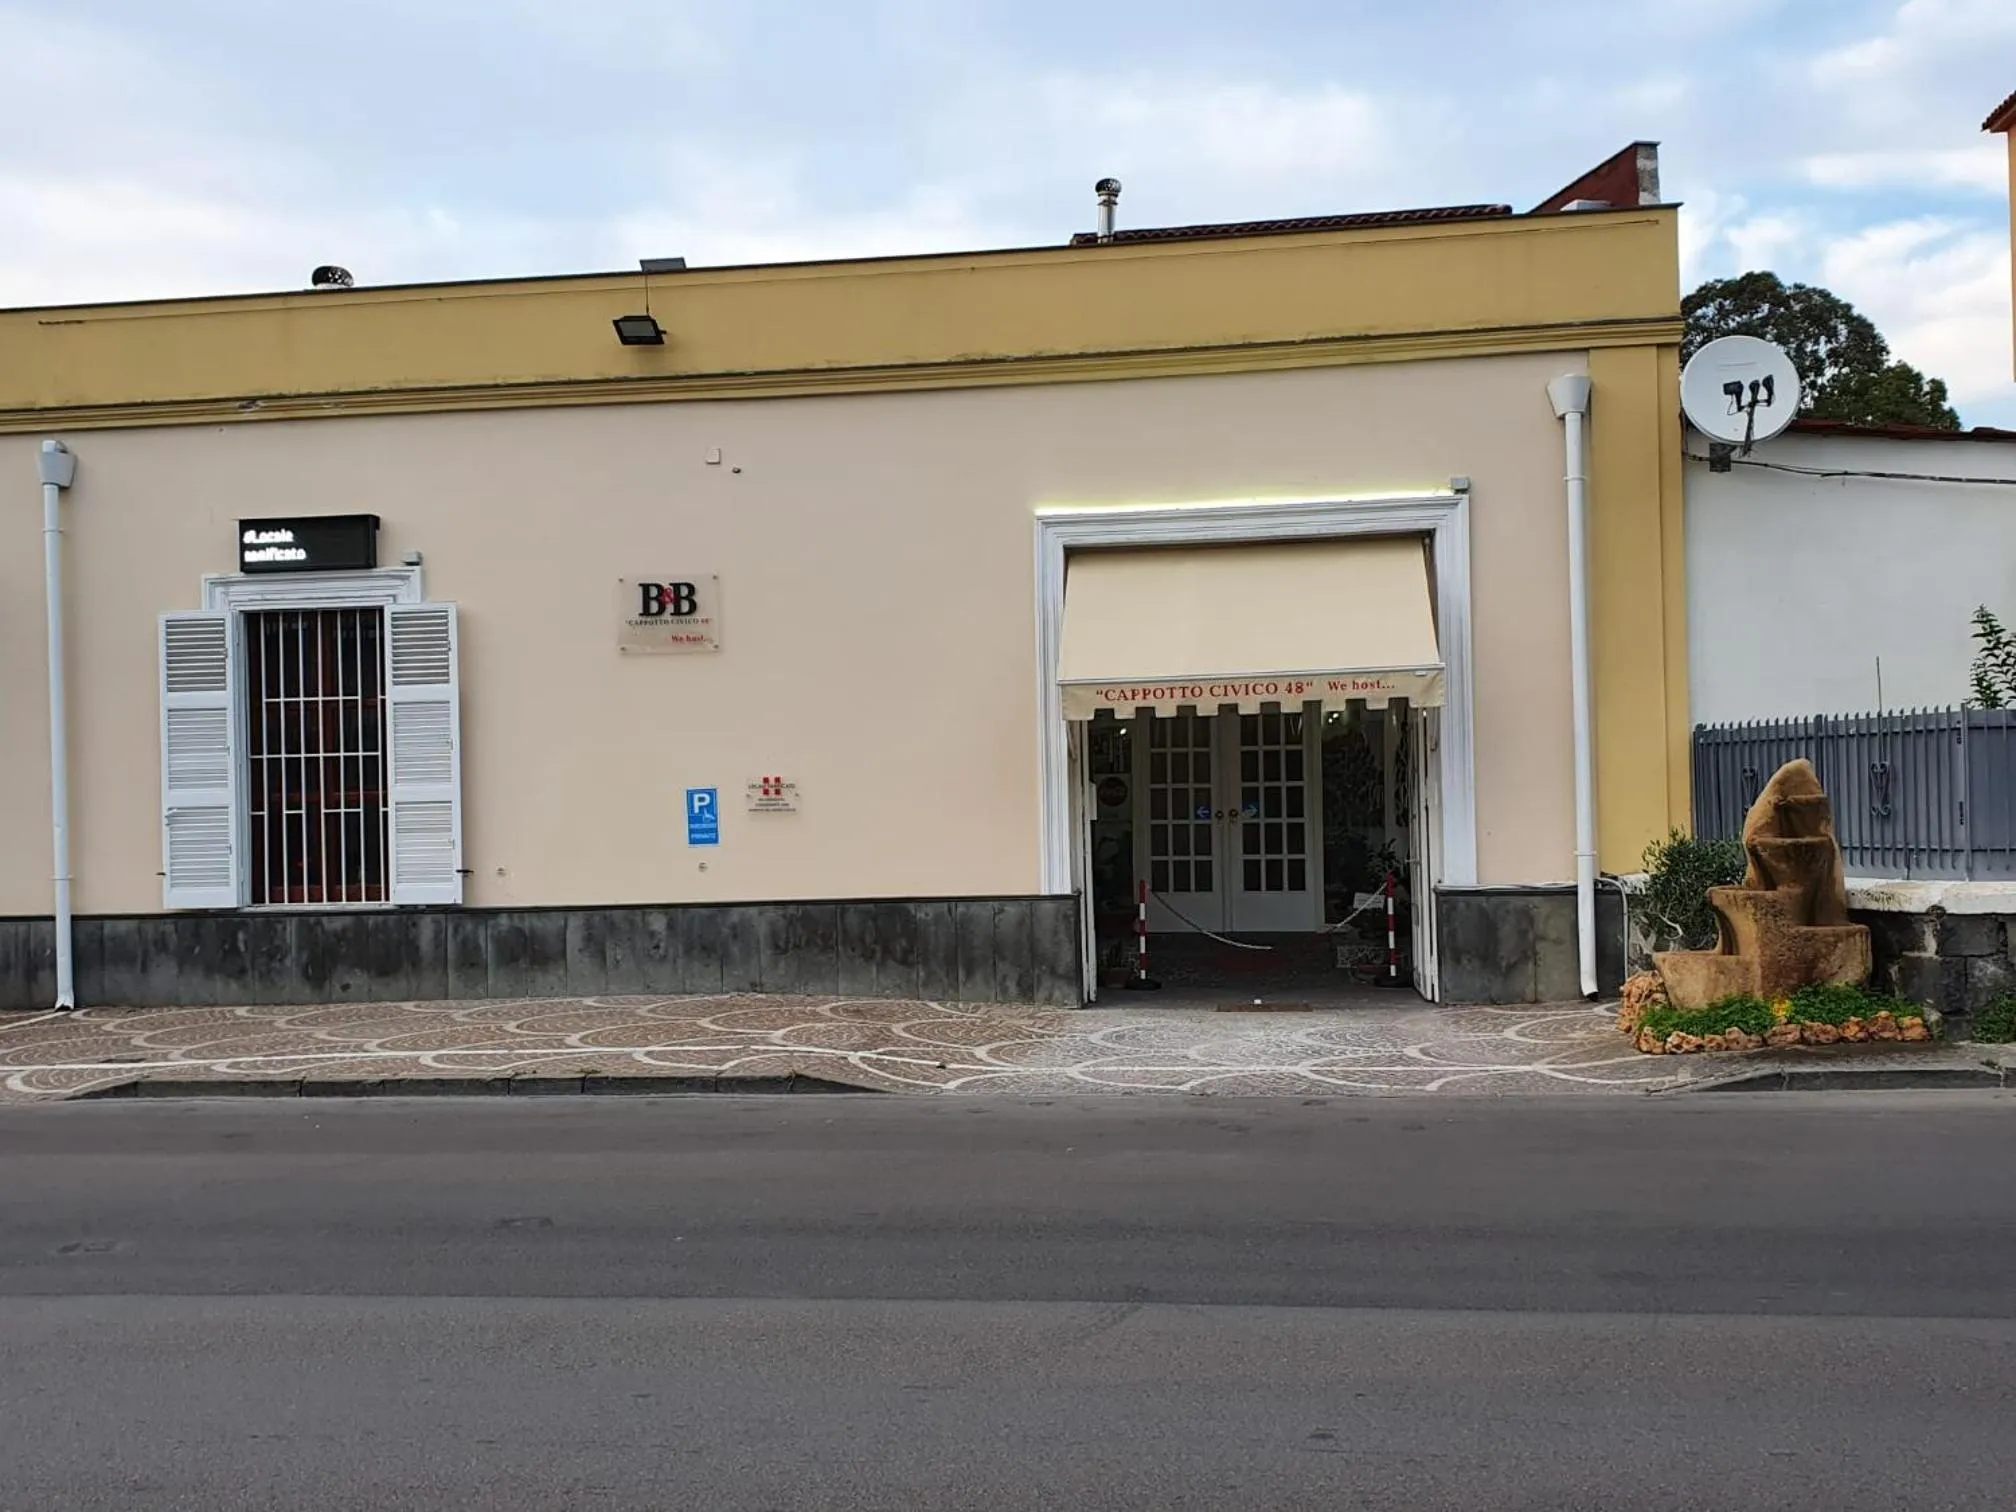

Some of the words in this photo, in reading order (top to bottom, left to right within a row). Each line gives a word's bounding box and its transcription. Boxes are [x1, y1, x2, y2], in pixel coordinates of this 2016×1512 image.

[638, 582, 697, 617] B&B
[1209, 681, 1278, 698] CIVICO
[1328, 679, 1348, 692] We
[1352, 678, 1396, 691] host...
[693, 793, 710, 814] P
